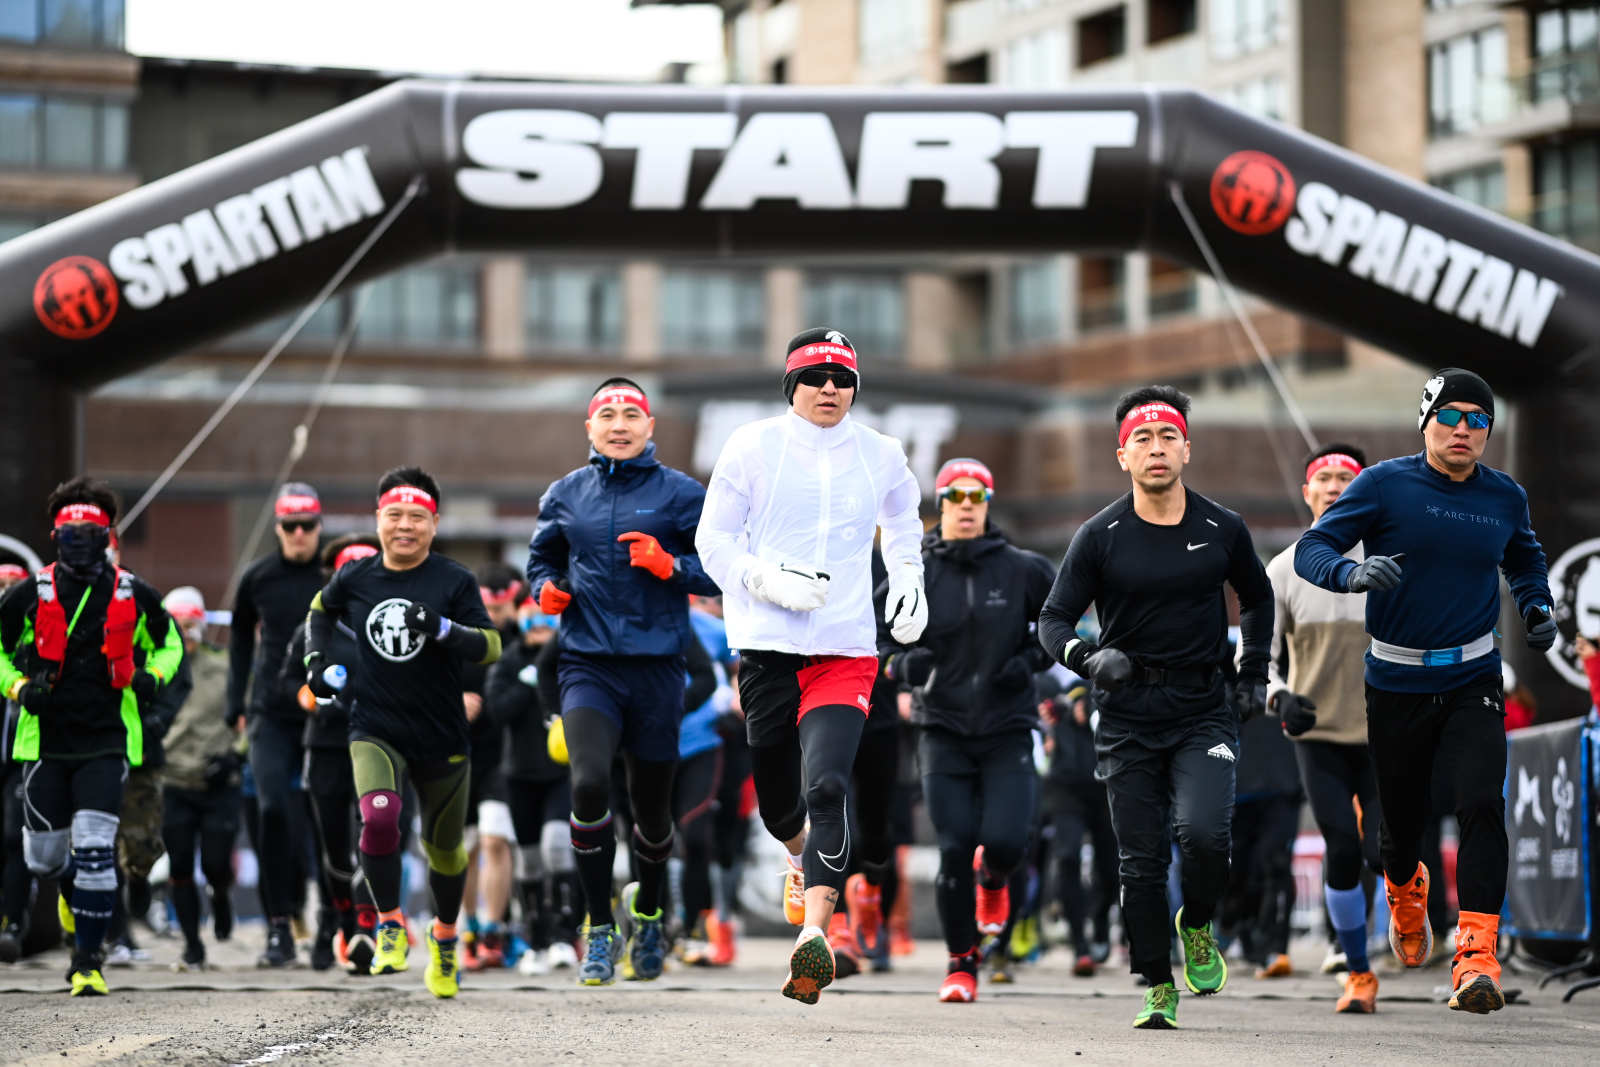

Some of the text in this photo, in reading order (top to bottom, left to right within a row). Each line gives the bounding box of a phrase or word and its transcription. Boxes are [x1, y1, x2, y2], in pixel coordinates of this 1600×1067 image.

[456, 109, 1138, 210] START
[108, 147, 384, 309] SPARTAN
[1285, 181, 1557, 347] SPARTAN
[825, 355, 833, 363] 8
[1144, 411, 1159, 421] 20
